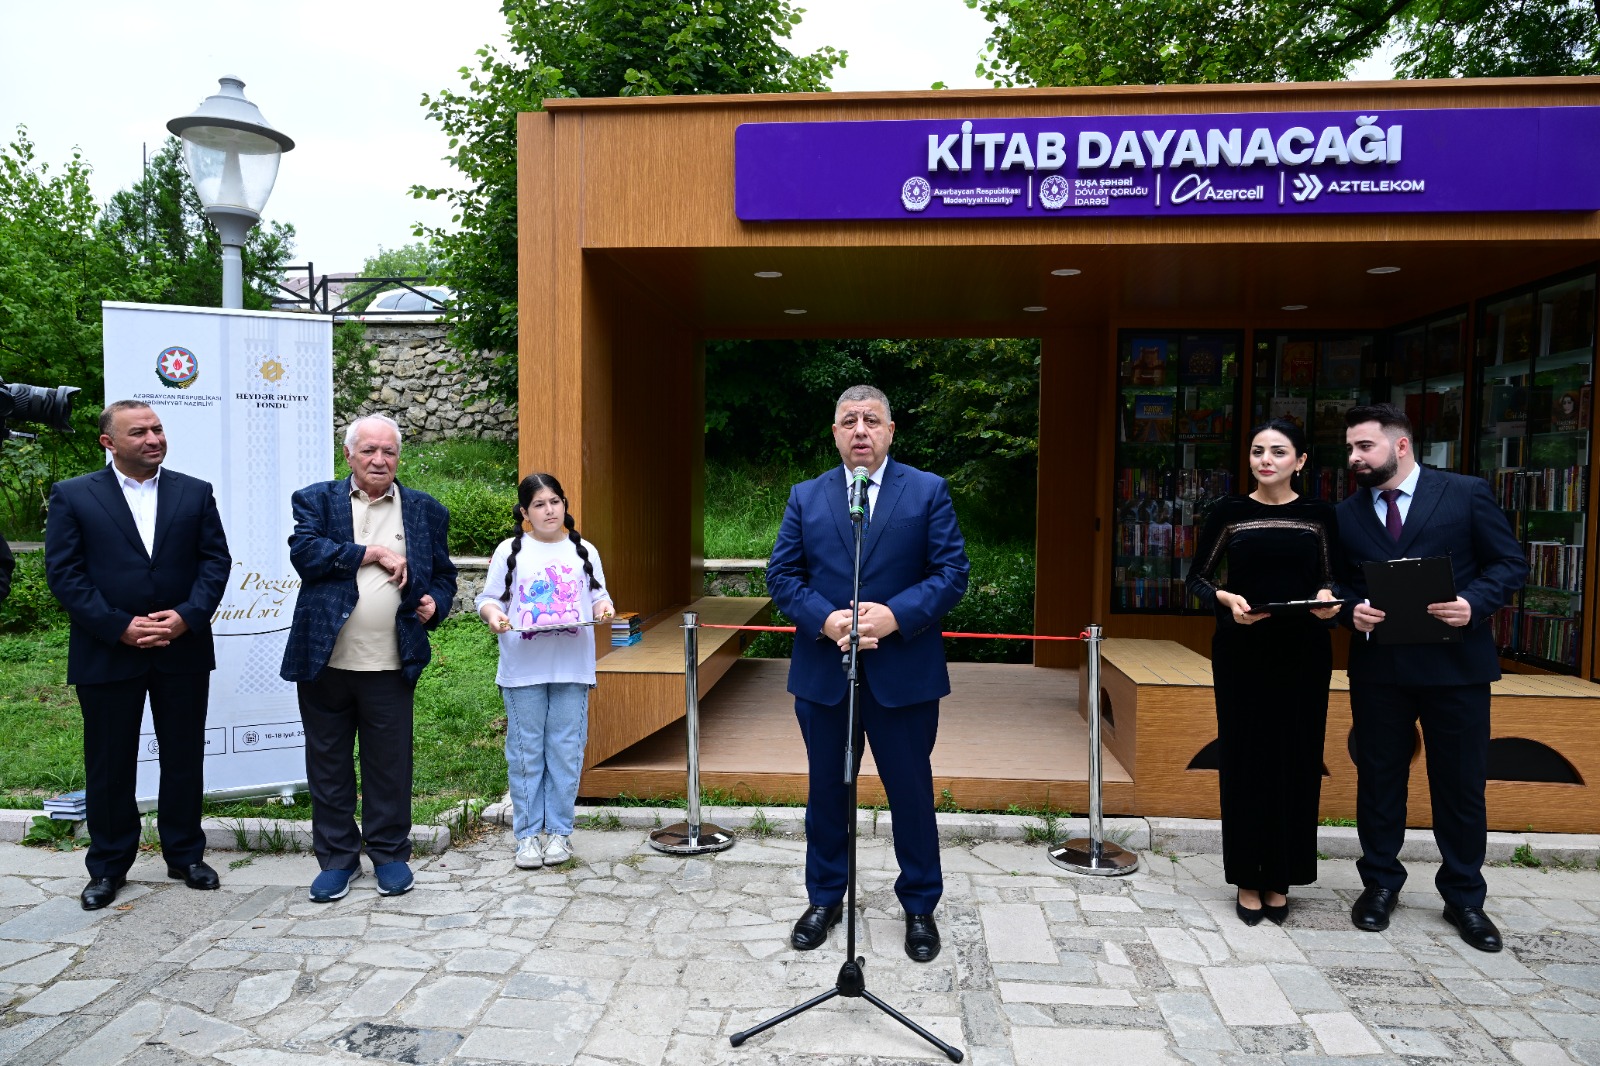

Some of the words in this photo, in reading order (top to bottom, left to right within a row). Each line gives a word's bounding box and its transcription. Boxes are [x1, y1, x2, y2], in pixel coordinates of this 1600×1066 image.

[927, 120, 1066, 172] KİTAB
[1076, 115, 1404, 170] DAYANACAĞI
[1074, 179, 1098, 188] ŞUŞA
[1099, 176, 1133, 187] ŞƏHƏRİ
[1327, 180, 1425, 192] AZTELEKOM
[933, 188, 975, 197] Azərbaycan
[1075, 187, 1109, 196] DÖVLƏT
[1110, 186, 1148, 197] QORUĞU
[1204, 185, 1264, 200] Azercell
[1074, 197, 1109, 206] İDARƏSİ
[133, 393, 176, 401] AZƏRBAYCAN
[236, 393, 275, 401] HEYDƏR
[277, 393, 309, 402] ƏLİYEV
